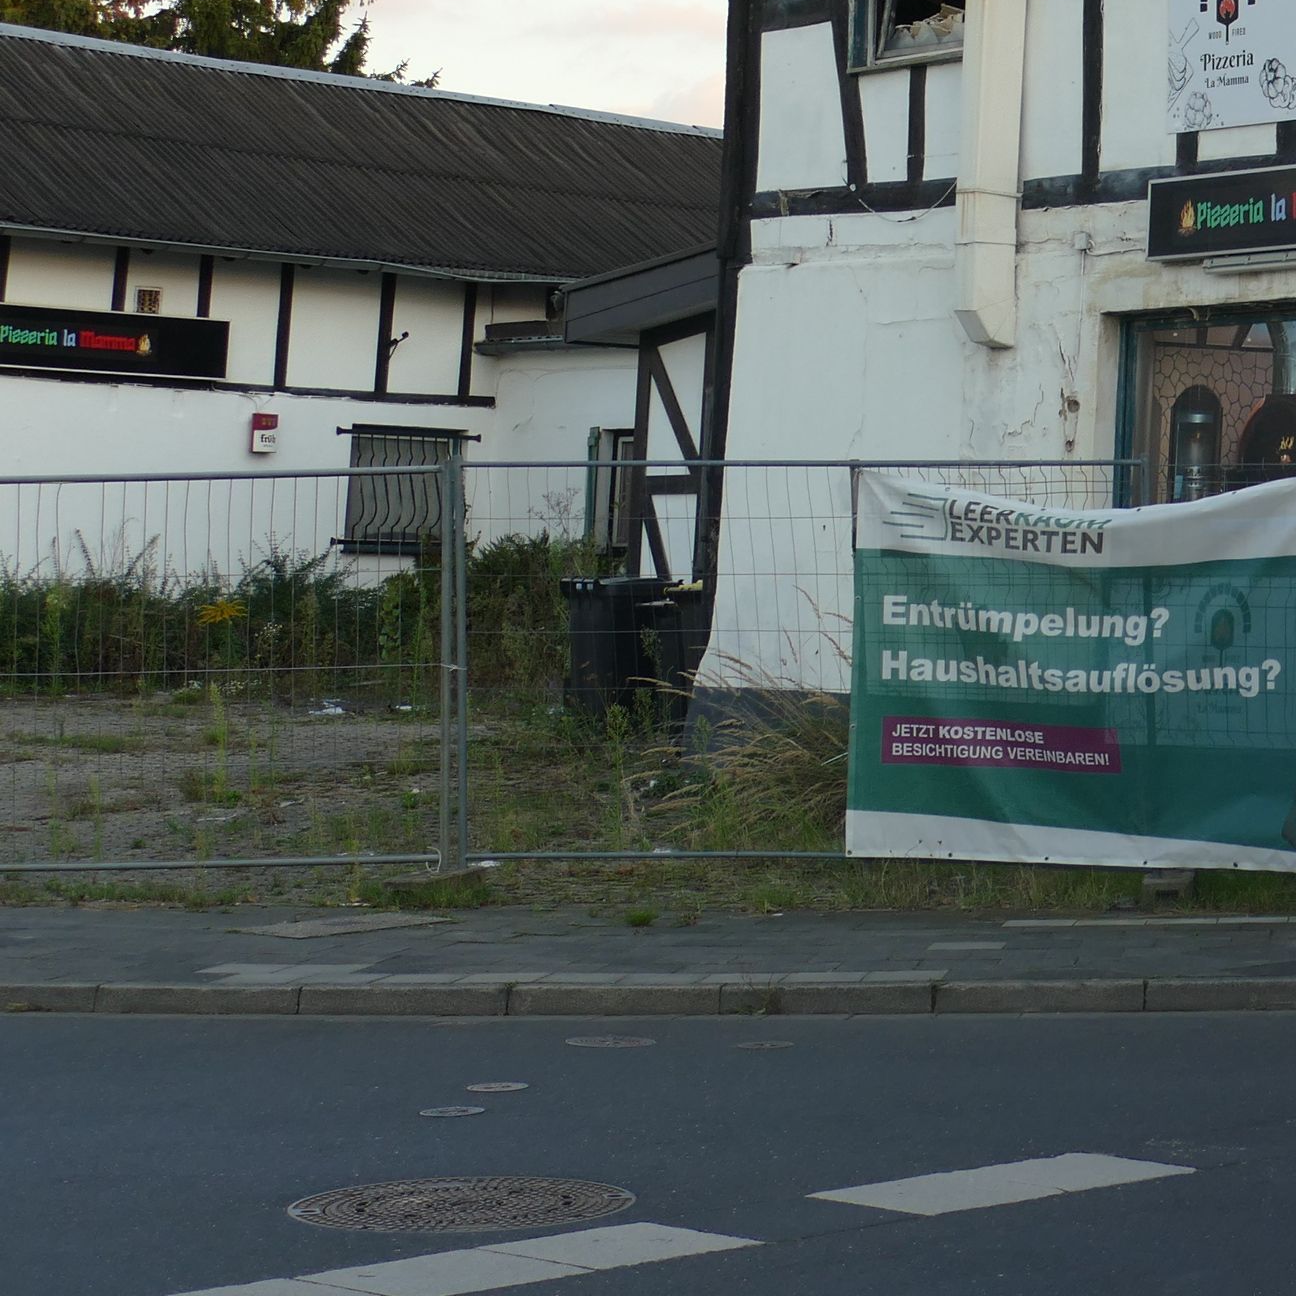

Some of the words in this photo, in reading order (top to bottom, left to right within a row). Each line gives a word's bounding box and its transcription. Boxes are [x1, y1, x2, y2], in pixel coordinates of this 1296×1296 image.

[1200, 50, 1254, 72] Pizzeria
[1205, 77, 1216, 88] La
[1217, 74, 1249, 86] Mamma
[1196, 197, 1265, 230] Pizzeria
[1271, 193, 1287, 222] la
[0, 325, 58, 346] Pizzeria
[63, 329, 77, 347] la
[80, 330, 136, 351] Mamma
[950, 521, 1104, 554] EXPERTEN
[882, 595, 1170, 646] Entrümpelung?
[881, 650, 1282, 698] Haushaltsauflösung?
[892, 724, 935, 738] JETZT
[939, 726, 1044, 744] KOSTENLOSE
[892, 743, 1003, 759] BESICHTIGUNG
[1007, 747, 1109, 766] VEREINBAREN!
